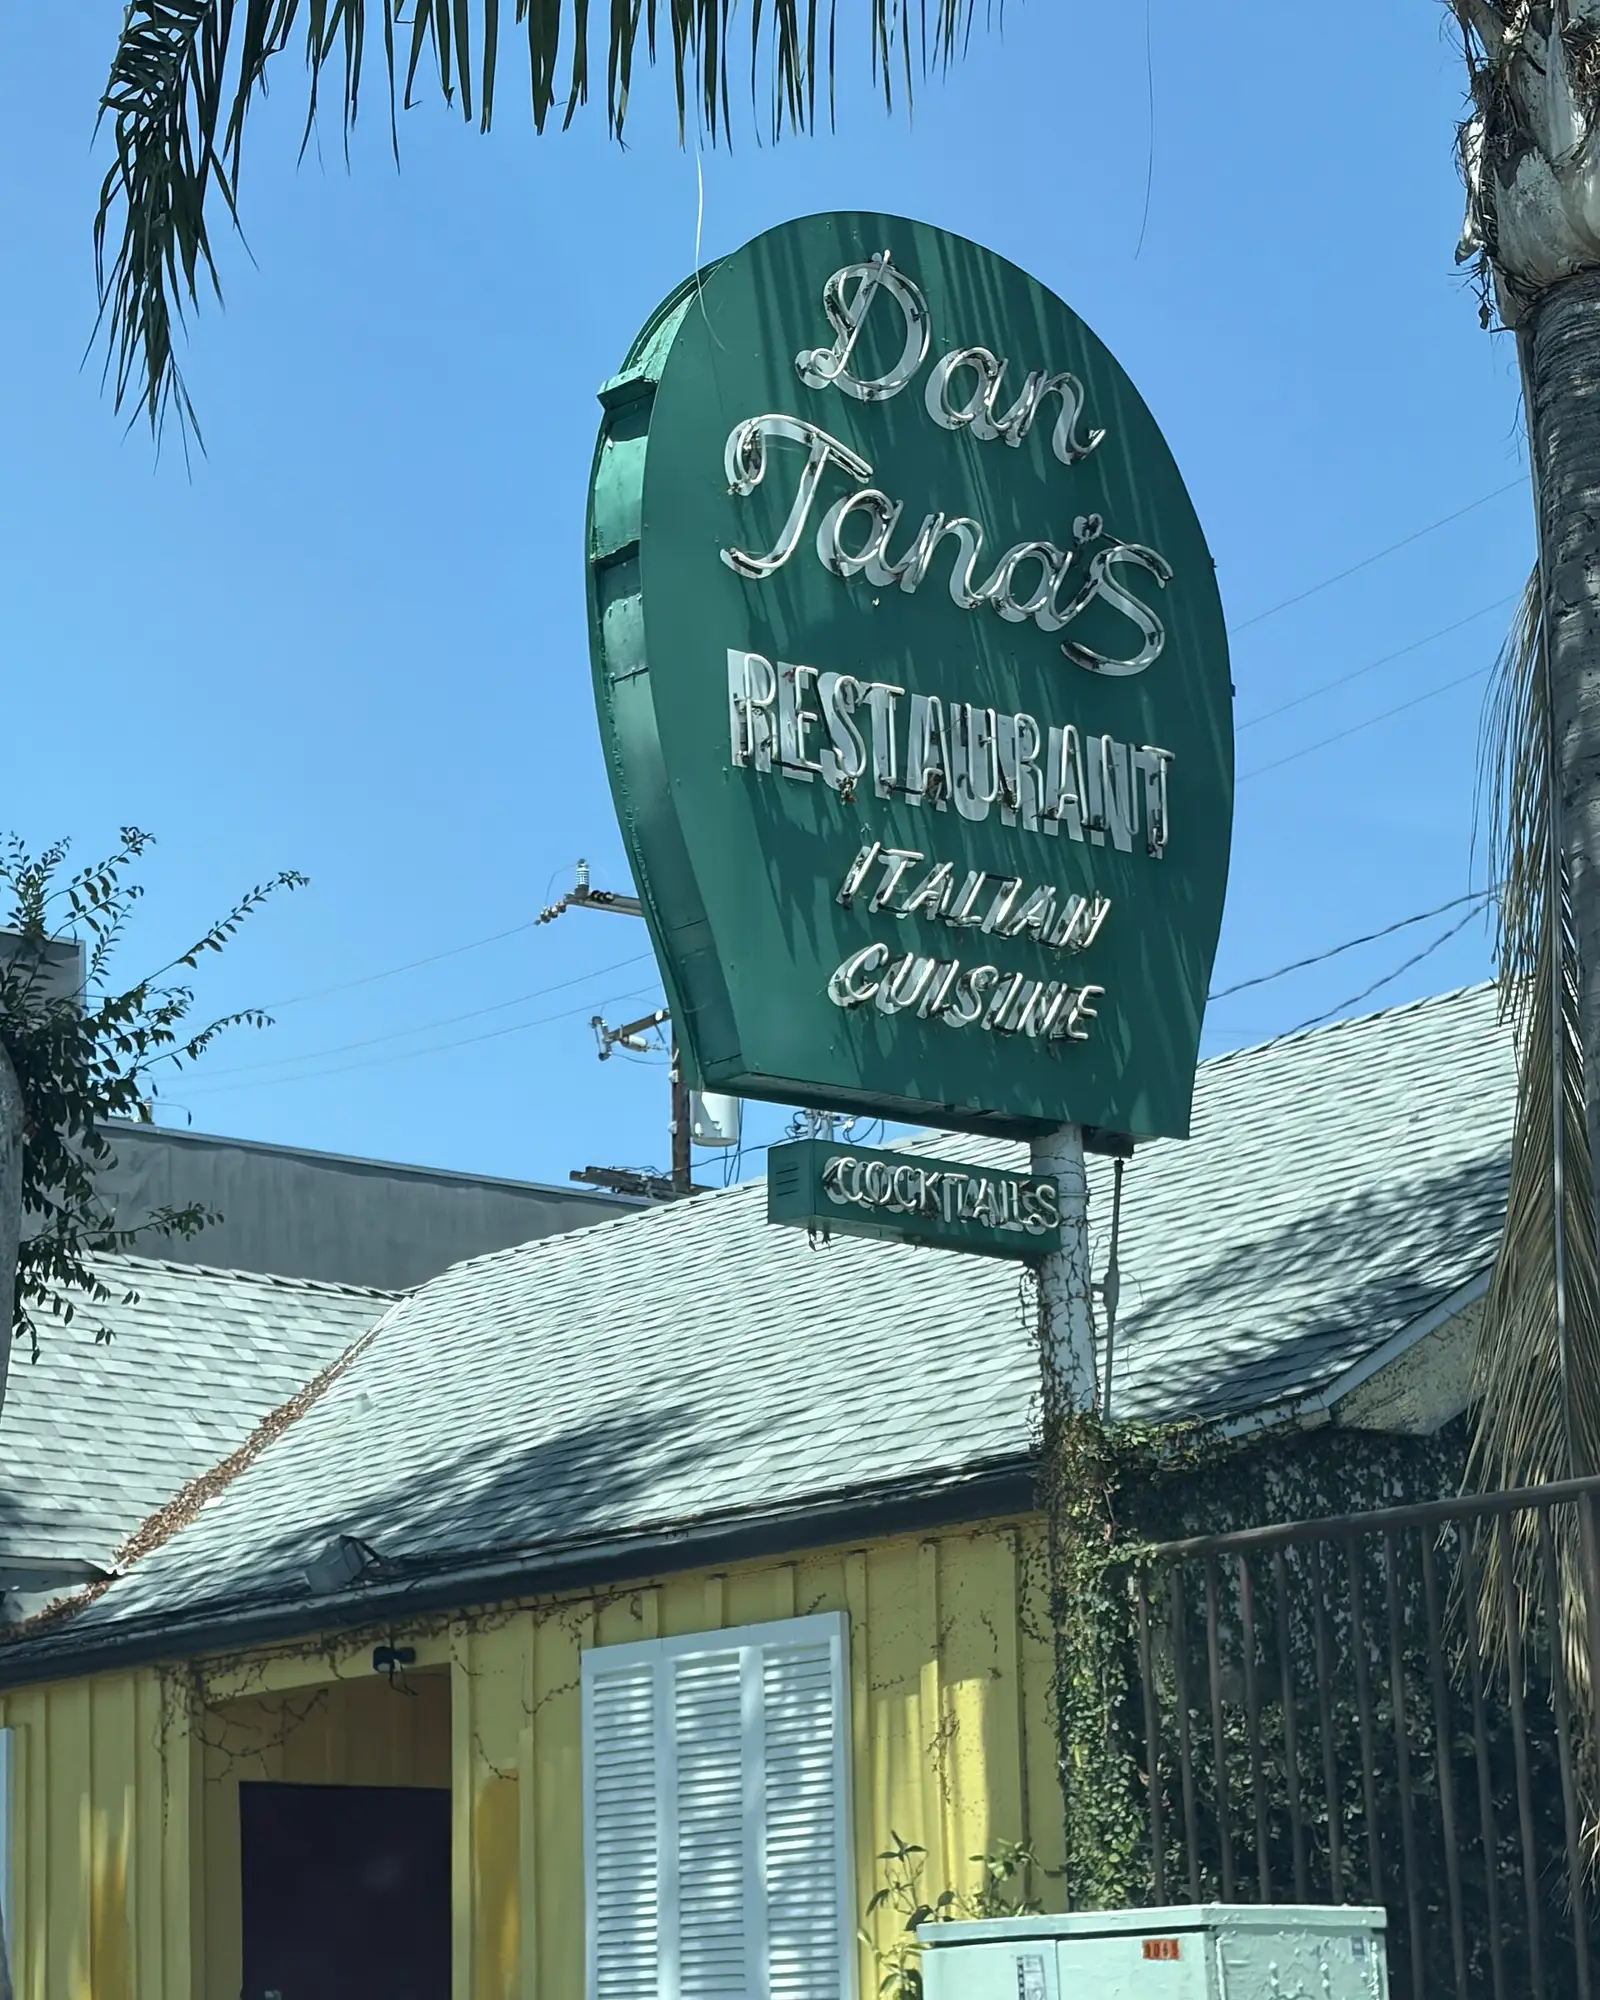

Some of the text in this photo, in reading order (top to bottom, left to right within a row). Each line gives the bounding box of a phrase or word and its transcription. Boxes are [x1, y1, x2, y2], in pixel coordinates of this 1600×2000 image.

[795, 250, 1106, 465] Dan
[727, 649, 1176, 859] RESTAURANT
[836, 841, 1111, 948] ITALIAN
[827, 942, 1105, 1040] CUISINE
[821, 1156, 1061, 1235] COCKTAILS
